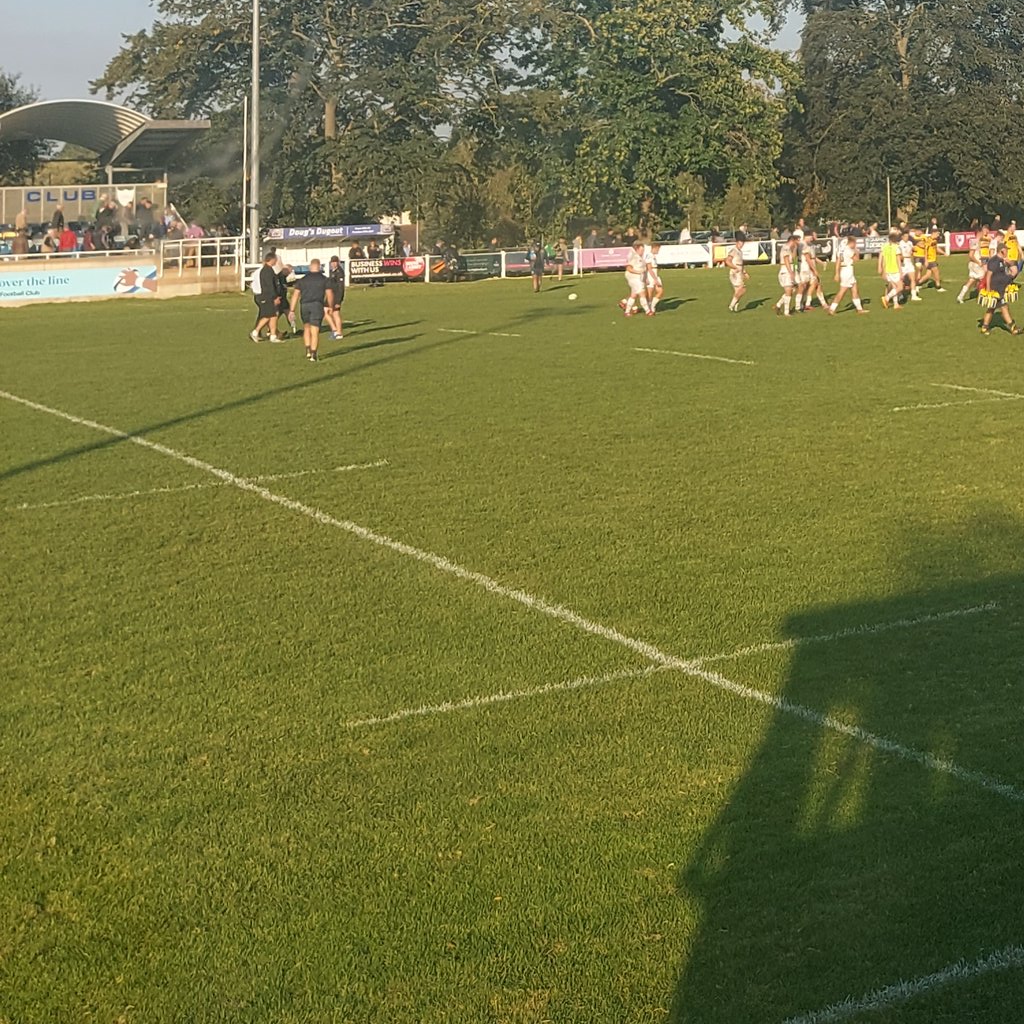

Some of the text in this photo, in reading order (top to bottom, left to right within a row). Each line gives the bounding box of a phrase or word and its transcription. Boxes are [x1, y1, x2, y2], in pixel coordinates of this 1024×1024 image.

[27, 190, 96, 202] CLUB
[289, 228, 315, 236] Doug's
[316, 227, 344, 236] Dugout
[0, 276, 70, 287] over the line
